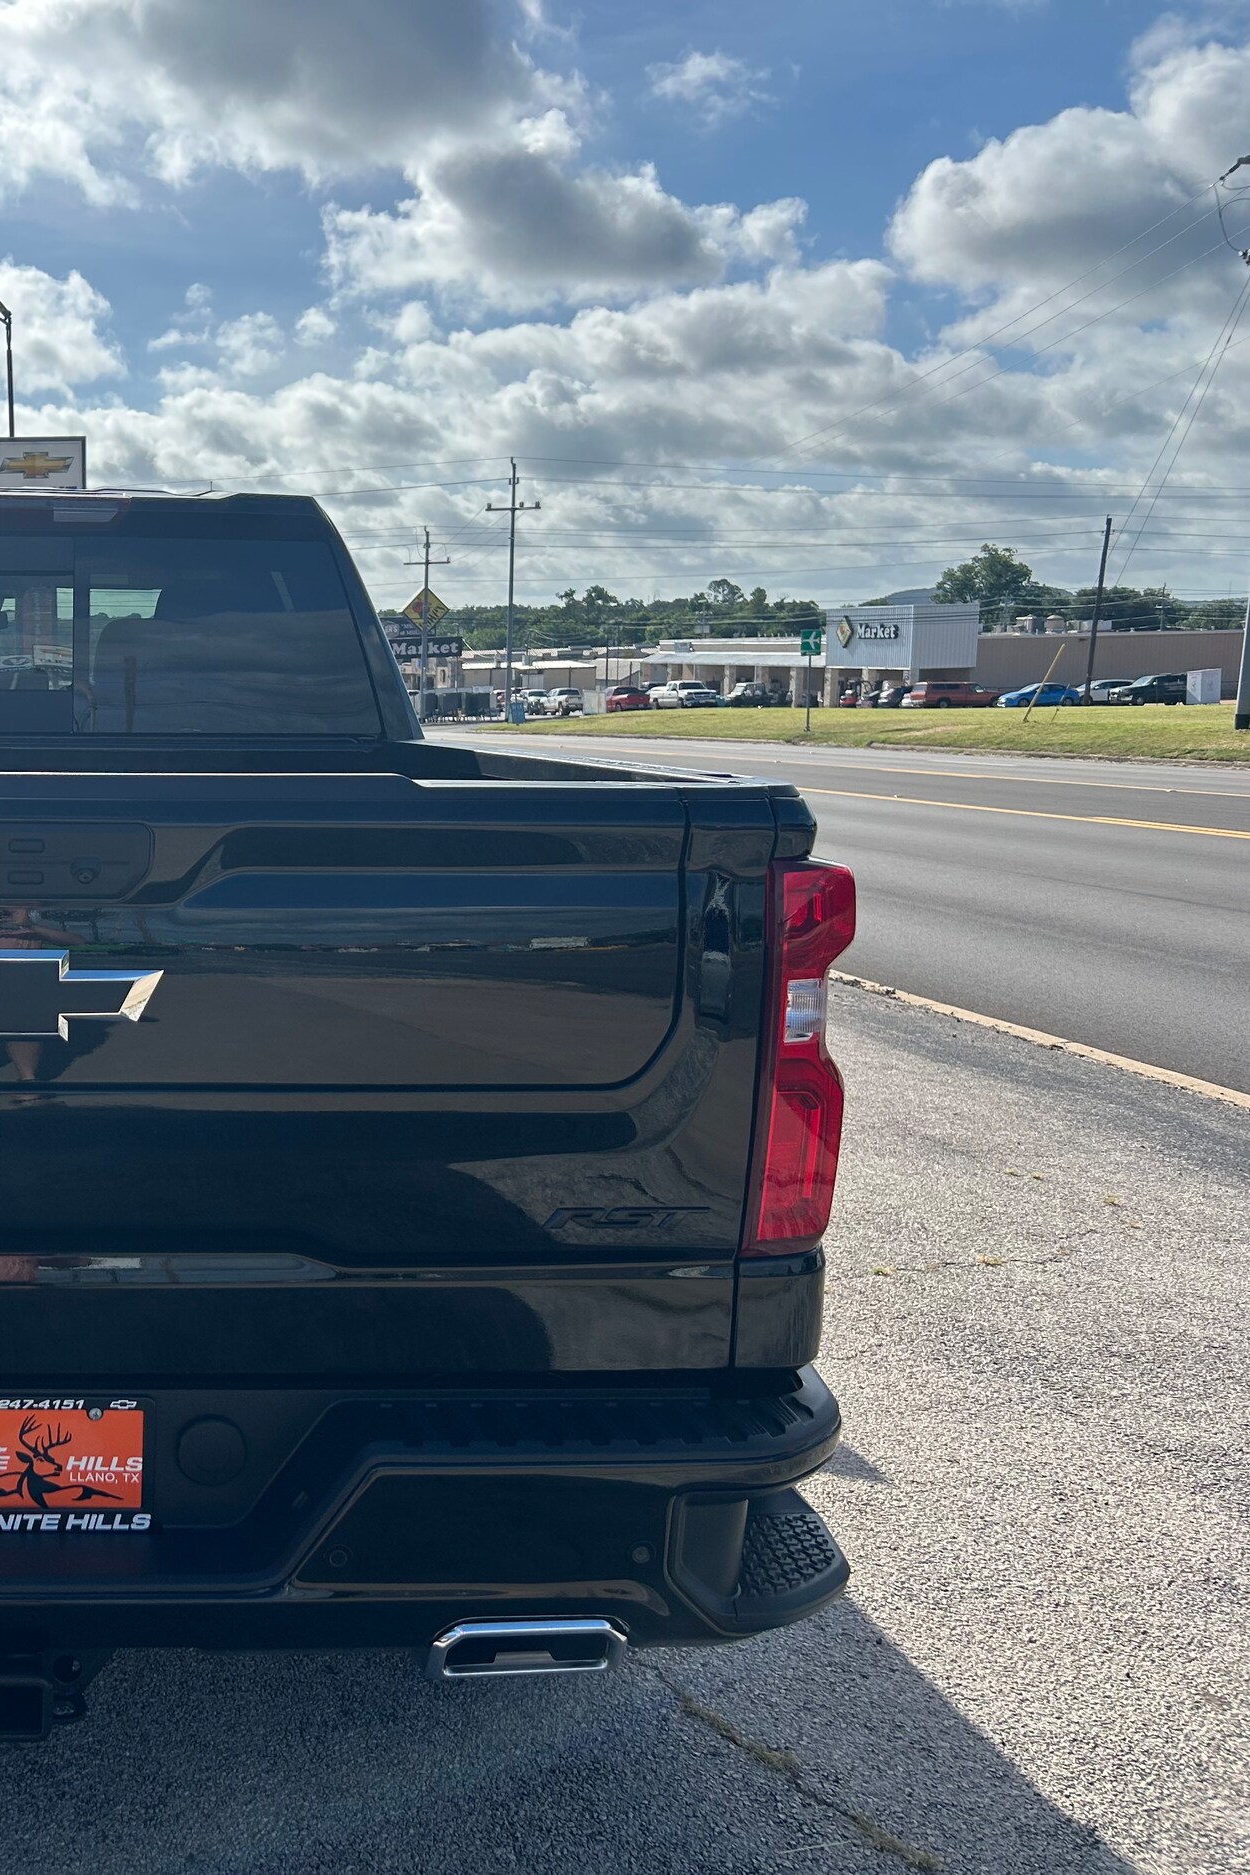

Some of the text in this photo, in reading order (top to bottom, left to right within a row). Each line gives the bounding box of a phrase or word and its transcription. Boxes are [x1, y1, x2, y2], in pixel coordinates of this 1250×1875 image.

[857, 624, 896, 638] Market
[541, 1206, 711, 1229] RST
[65, 1456, 143, 1471] HILLS
[69, 1472, 140, 1484] LLANO, TX
[65, 1513, 151, 1531] HILLS
